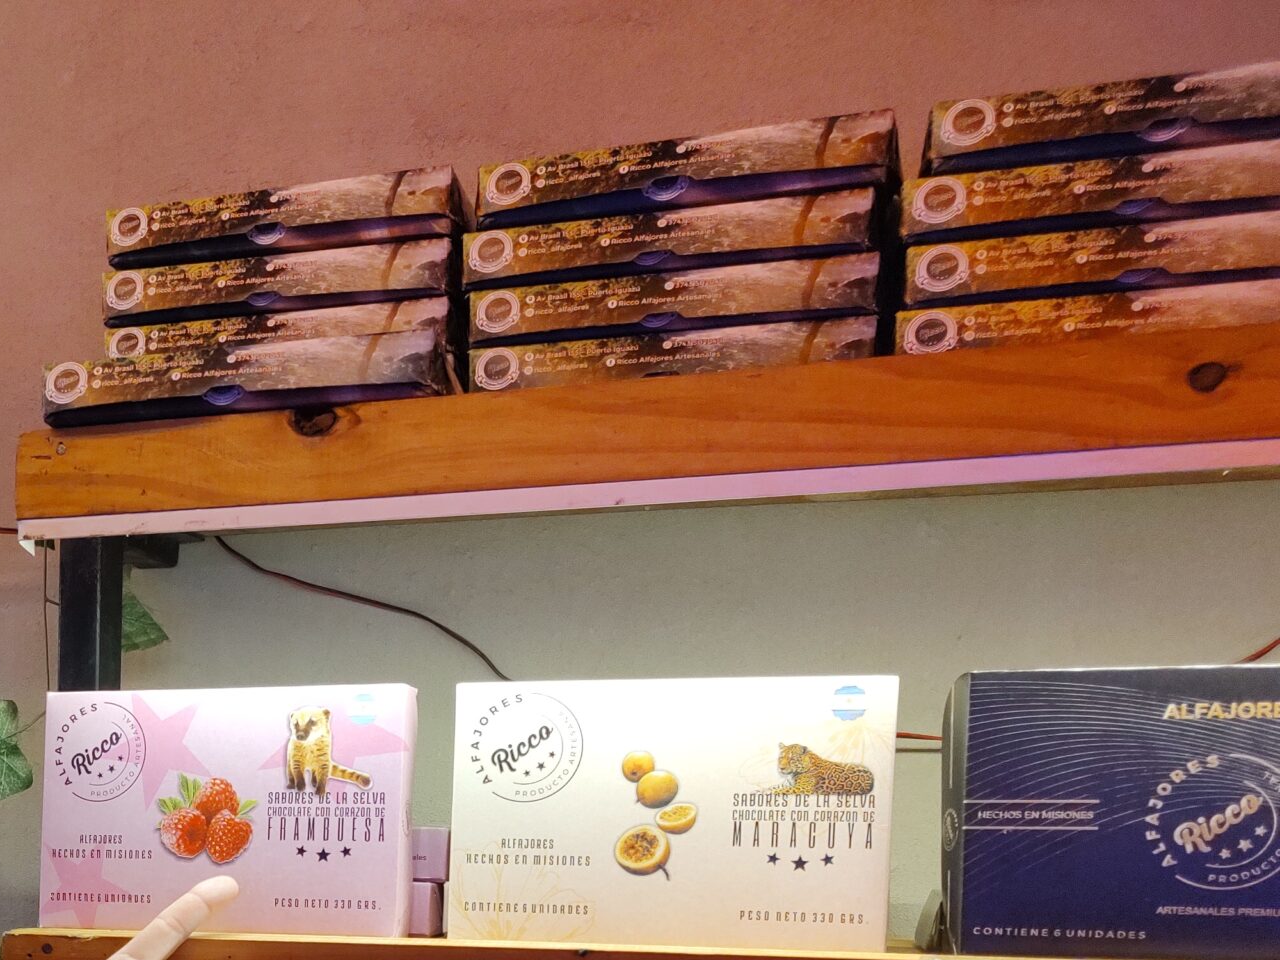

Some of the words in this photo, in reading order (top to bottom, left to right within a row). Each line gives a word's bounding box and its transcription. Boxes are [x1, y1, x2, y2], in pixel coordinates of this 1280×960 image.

[629, 163, 651, 172] Ricco
[611, 236, 633, 245] Ricco
[182, 371, 202, 380] Ricco
[204, 367, 237, 377] Alfajores
[55, 704, 98, 785] ALFAJORES
[471, 694, 523, 784] ALFAJORES
[71, 732, 122, 775] Ricco
[491, 726, 553, 773] Ricco
[90, 771, 134, 796] PRODUCTO
[515, 769, 569, 797] PRODUCTO
[267, 792, 313, 804] SABORES
[319, 792, 331, 804] DE
[336, 792, 347, 804] LA
[353, 792, 385, 804] SELVA
[733, 793, 788, 808] SABORES
[795, 794, 810, 807] DE
[816, 794, 830, 808] LA
[837, 794, 875, 808] SELVA
[267, 806, 311, 817] CHOCOLATE
[315, 807, 330, 817] CON
[334, 807, 370, 817] CORAZON
[375, 807, 385, 817] DE
[732, 810, 786, 821] CHOCOLATE
[790, 810, 809, 821] CON
[814, 811, 857, 822] CORAZON
[863, 811, 875, 822] DE
[978, 811, 1022, 819] HECHOS
[1025, 811, 1040, 819] EN
[1041, 810, 1094, 819] MISIONES
[1145, 754, 1220, 868] ALFAJORES
[267, 817, 385, 842] FRAMBUESA
[1173, 794, 1264, 854] Ricco
[80, 834, 122, 844] ALFAJORES
[732, 821, 872, 849] MARACUYA
[501, 838, 554, 849] ALFAJORES
[52, 849, 86, 858] HECHOS
[91, 849, 101, 858] EN
[106, 849, 152, 859] MISIONES
[467, 854, 509, 864] HECHOS
[514, 854, 527, 864] EN
[533, 855, 591, 866] MISIONES
[105, 893, 151, 903] UNIDADES
[274, 898, 299, 908] PESO
[304, 899, 329, 908] NETO
[334, 900, 352, 909] 330
[464, 901, 518, 912] CONTIENE
[531, 903, 588, 915] UNIDADES
[1156, 906, 1235, 916] ARTESANALES
[739, 910, 769, 921] PESO
[776, 912, 806, 922] NETO
[812, 913, 834, 923] 330
[973, 927, 1049, 937] CONTIENE
[1054, 929, 1062, 937] 6
[1065, 929, 1147, 939] UNIDADES
